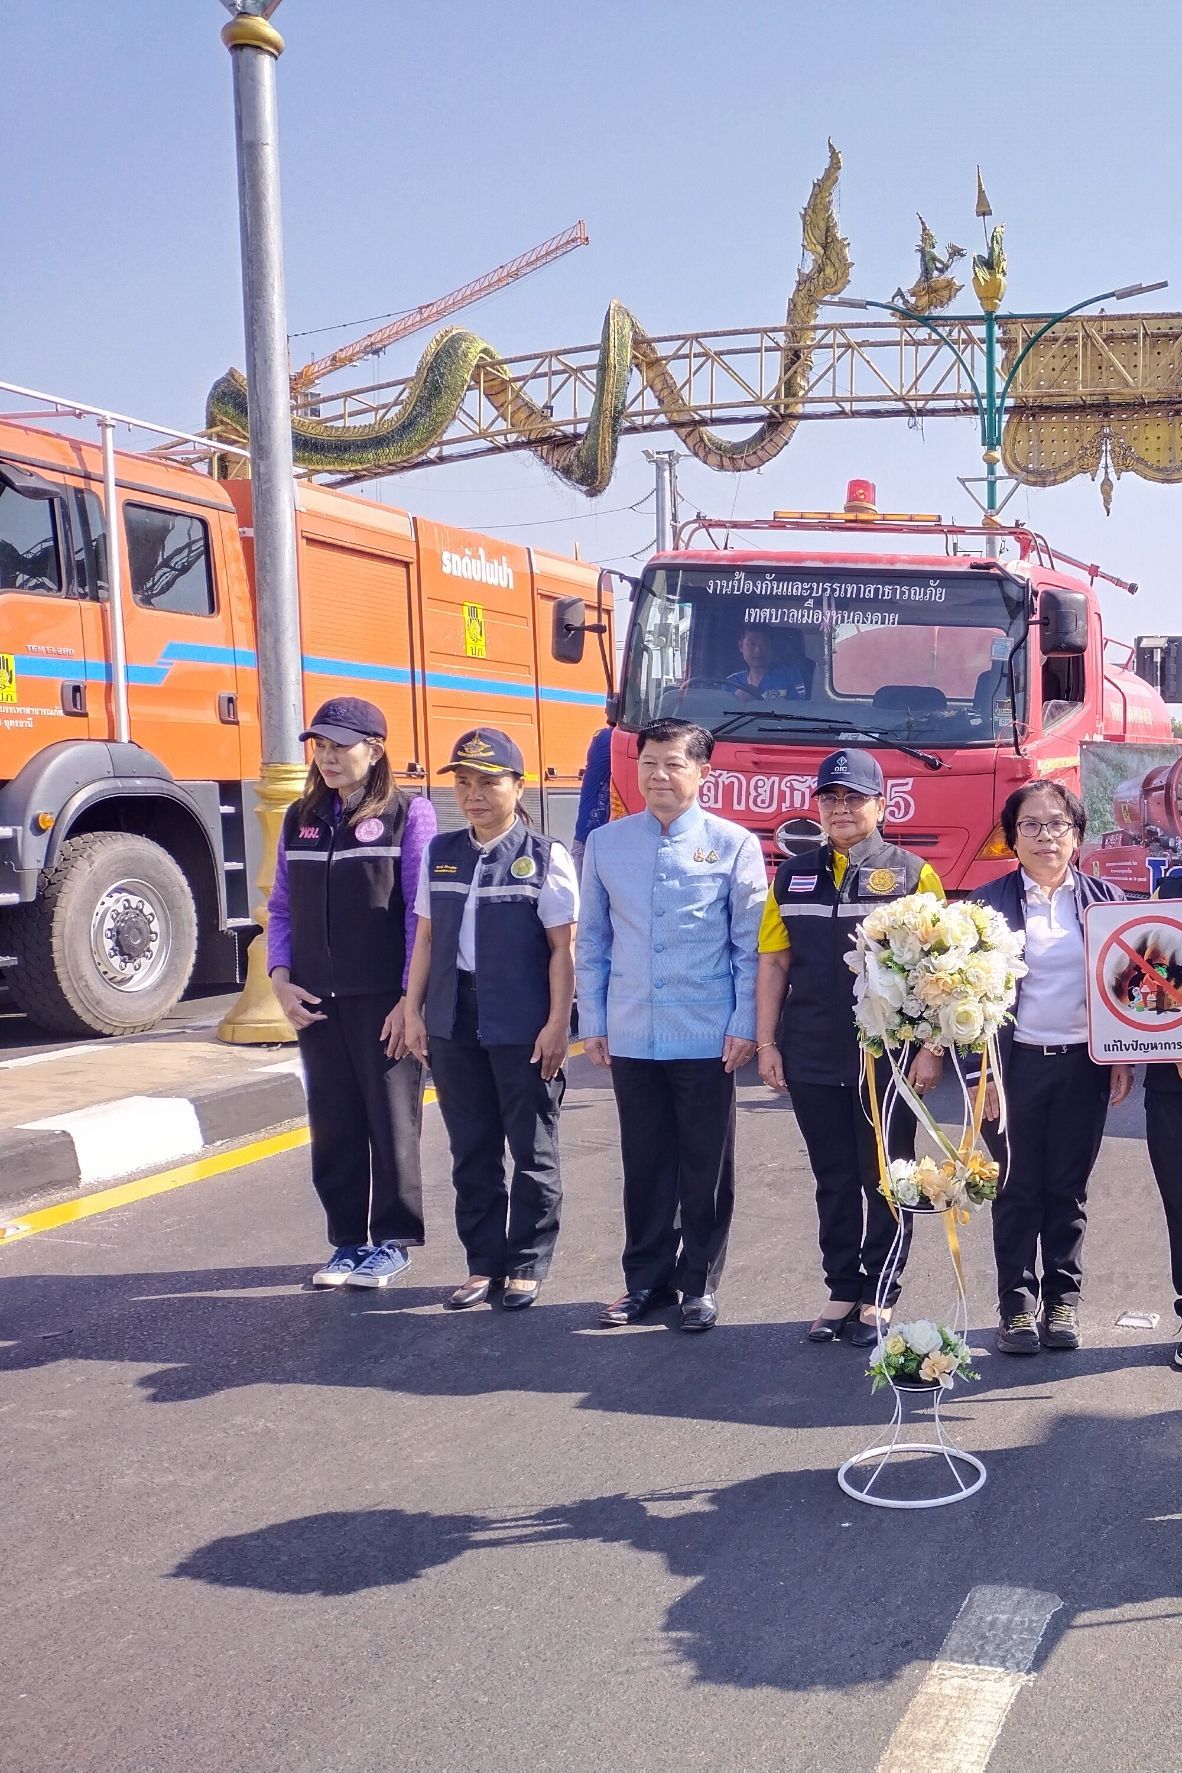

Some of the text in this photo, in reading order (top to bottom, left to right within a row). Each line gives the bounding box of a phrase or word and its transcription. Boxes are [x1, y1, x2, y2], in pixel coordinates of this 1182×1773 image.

[442, 547, 514, 590] รถดับไฟป่า
[706, 571, 946, 602] งานป้องกันและบรรเทาสาธารณภัย
[744, 598, 899, 627] เทศบาลเมืองหนองคาย
[700, 770, 915, 823] สายธ 5
